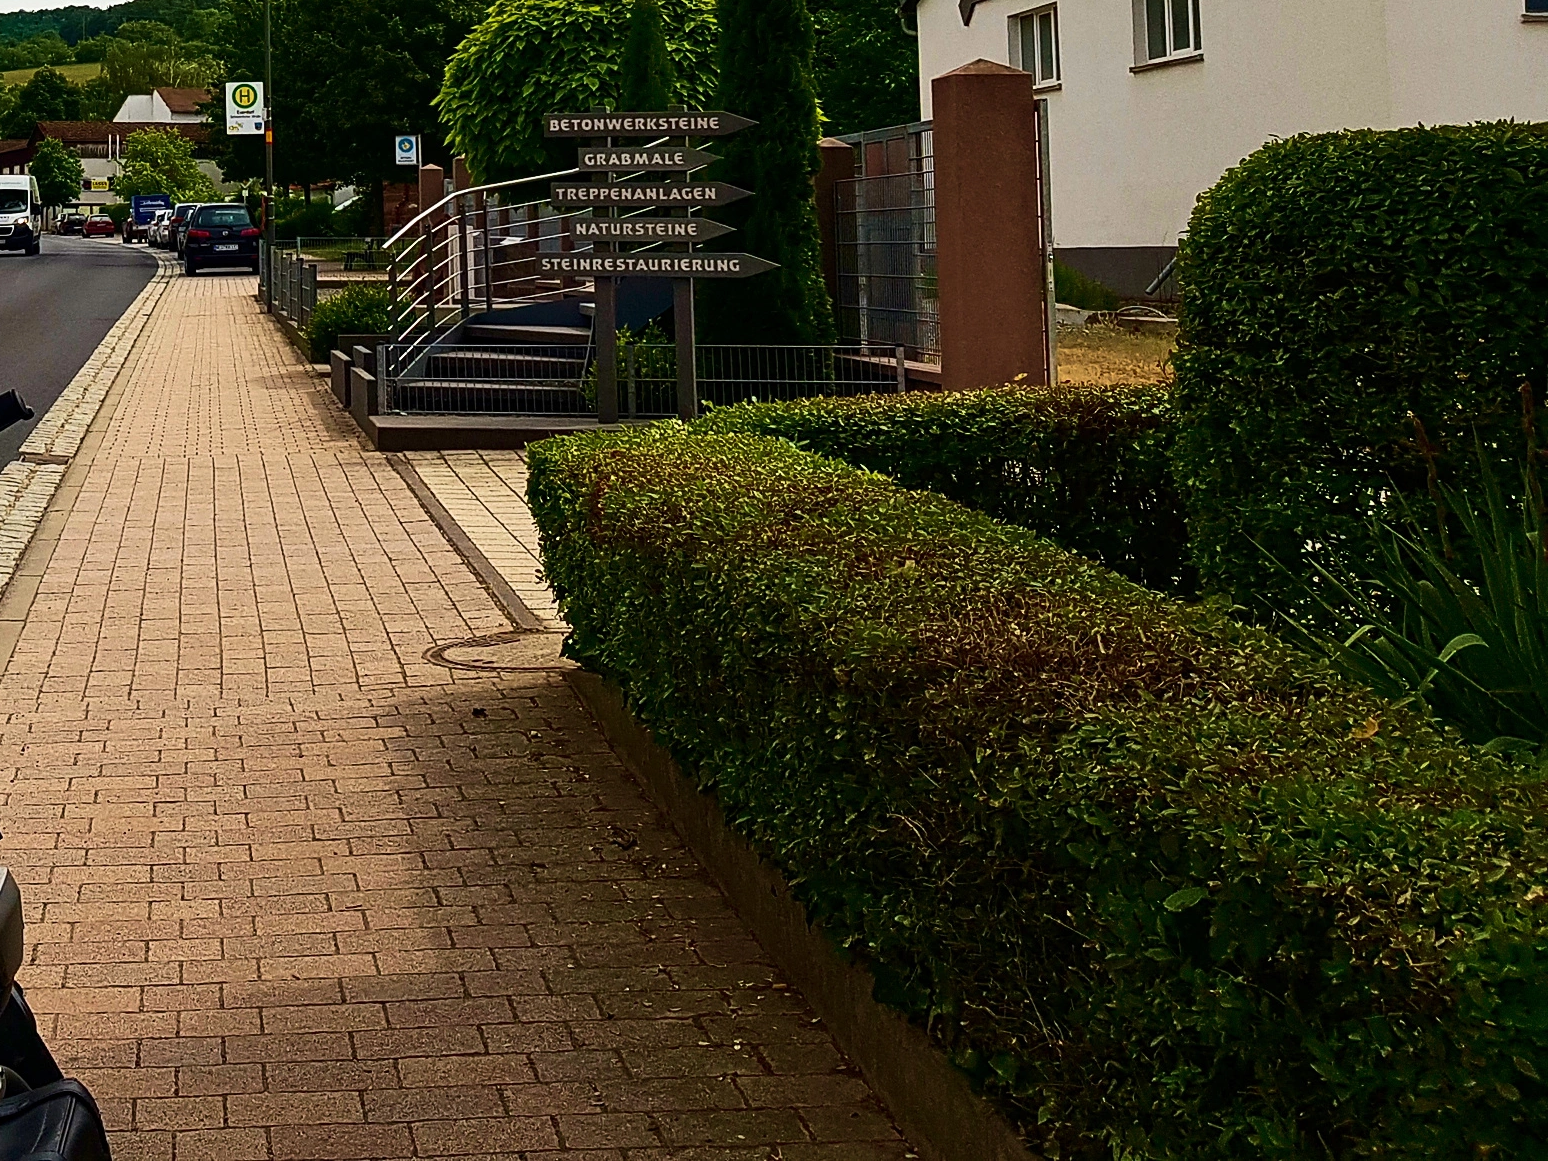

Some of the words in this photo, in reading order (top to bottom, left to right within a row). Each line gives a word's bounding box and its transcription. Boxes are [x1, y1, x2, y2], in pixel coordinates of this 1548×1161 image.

[549, 116, 720, 132] BETONWERKSTEINE
[584, 152, 685, 166] GRABMALE
[555, 187, 717, 200] TREPPENANLAGEN
[575, 223, 698, 236] NATURSTEINE
[541, 258, 741, 272] STEINRESTAURIERUNG
